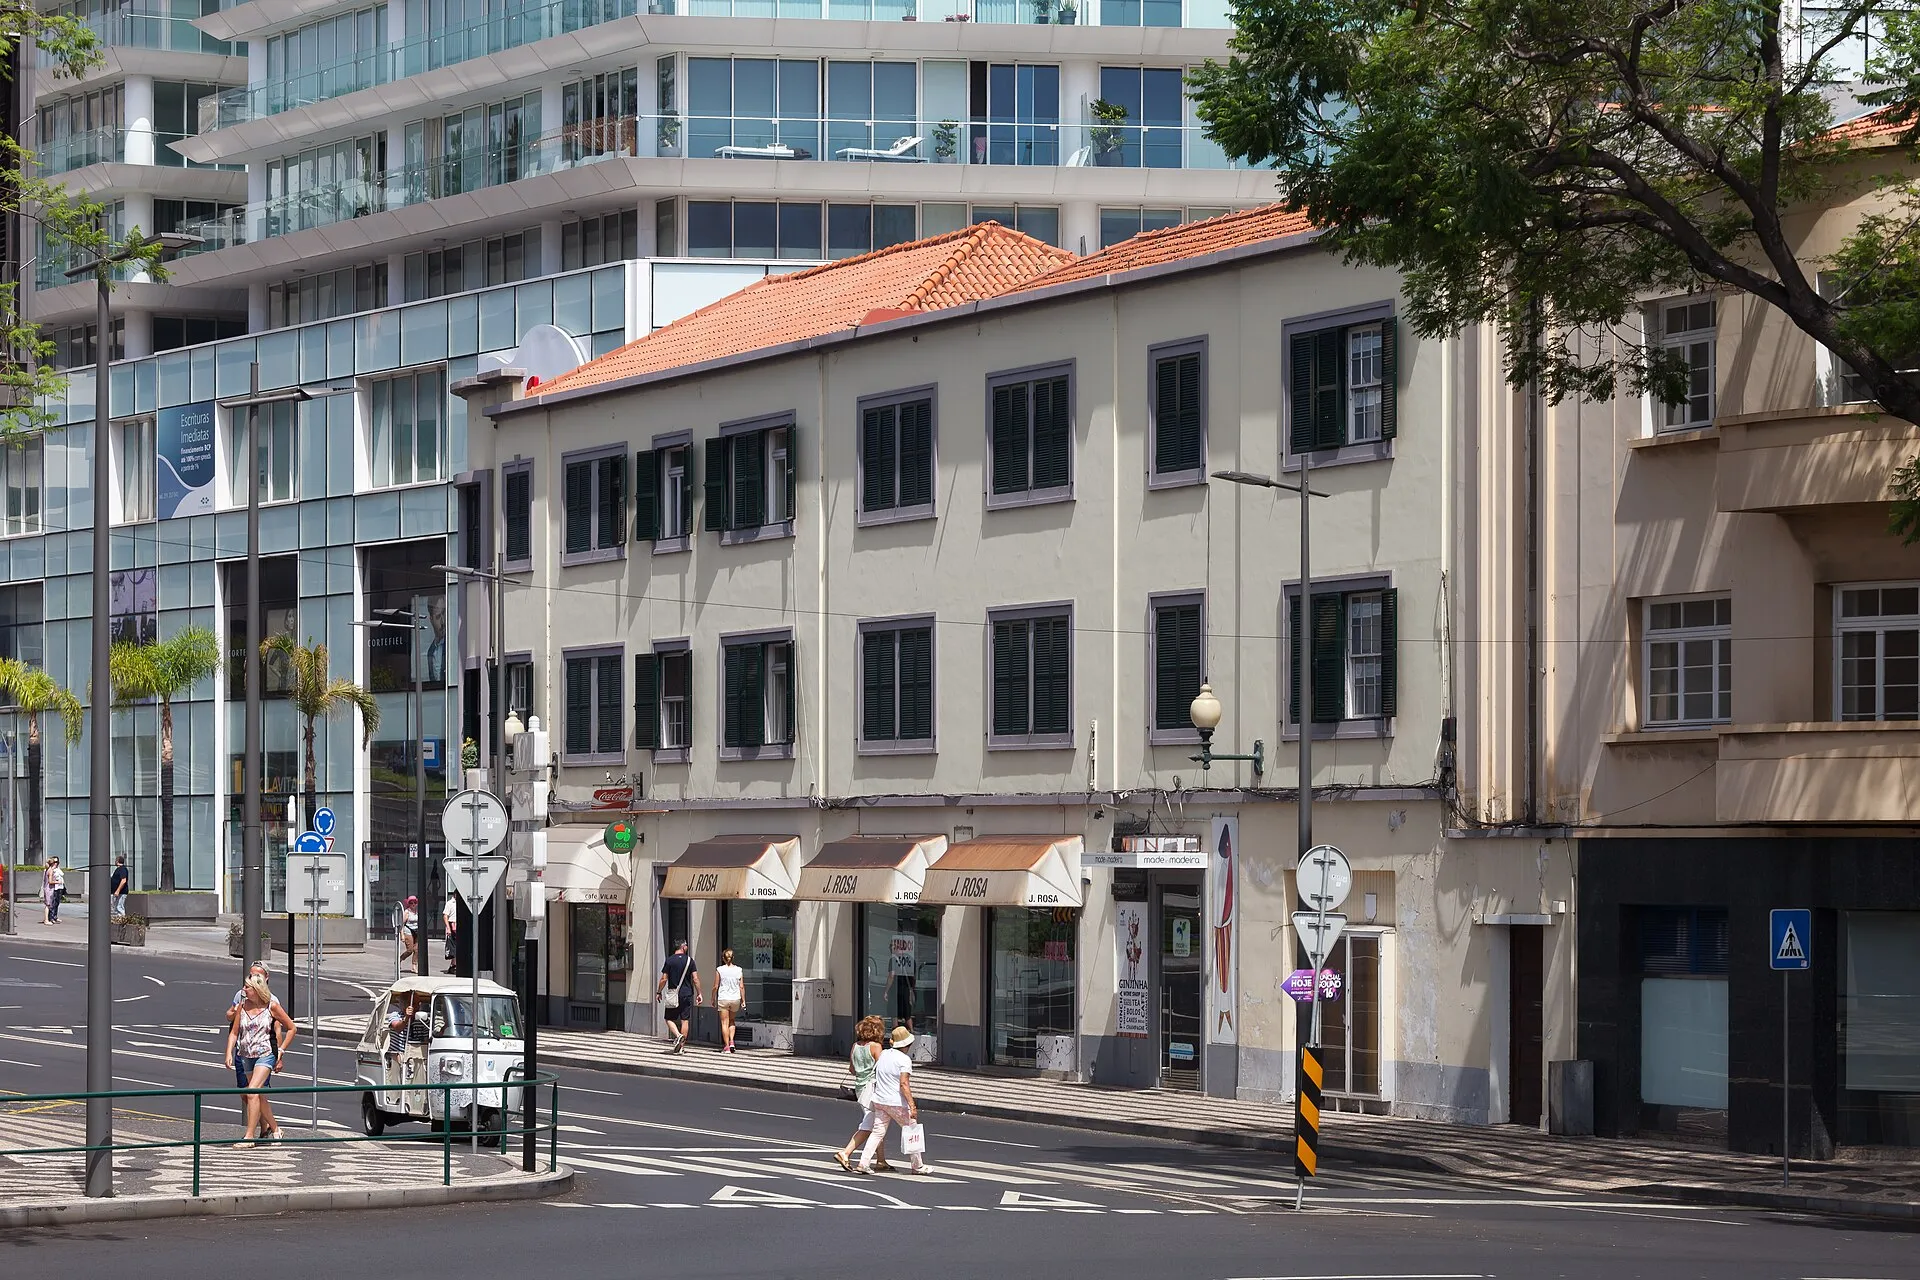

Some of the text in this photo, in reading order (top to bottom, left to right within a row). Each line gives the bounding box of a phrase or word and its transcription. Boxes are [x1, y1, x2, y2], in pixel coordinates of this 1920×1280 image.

[180, 413, 210, 427] Escrituras
[180, 428, 210, 443] Imediatas
[367, 636, 403, 648] CORTEFIEL
[227, 648, 247, 658] CORTE
[1143, 855, 1200, 864] made madeira
[687, 874, 718, 892] J. ROSA
[822, 875, 858, 894] J. ROSA
[950, 877, 989, 898] J. ROSA
[749, 888, 777, 896] J. ROSA
[894, 892, 902, 900] J.
[1028, 894, 1059, 903] J. ROSA
[1119, 979, 1148, 990] GINJINHA
[1291, 979, 1312, 988] HOJE
[1132, 999, 1140, 1007] TEA
